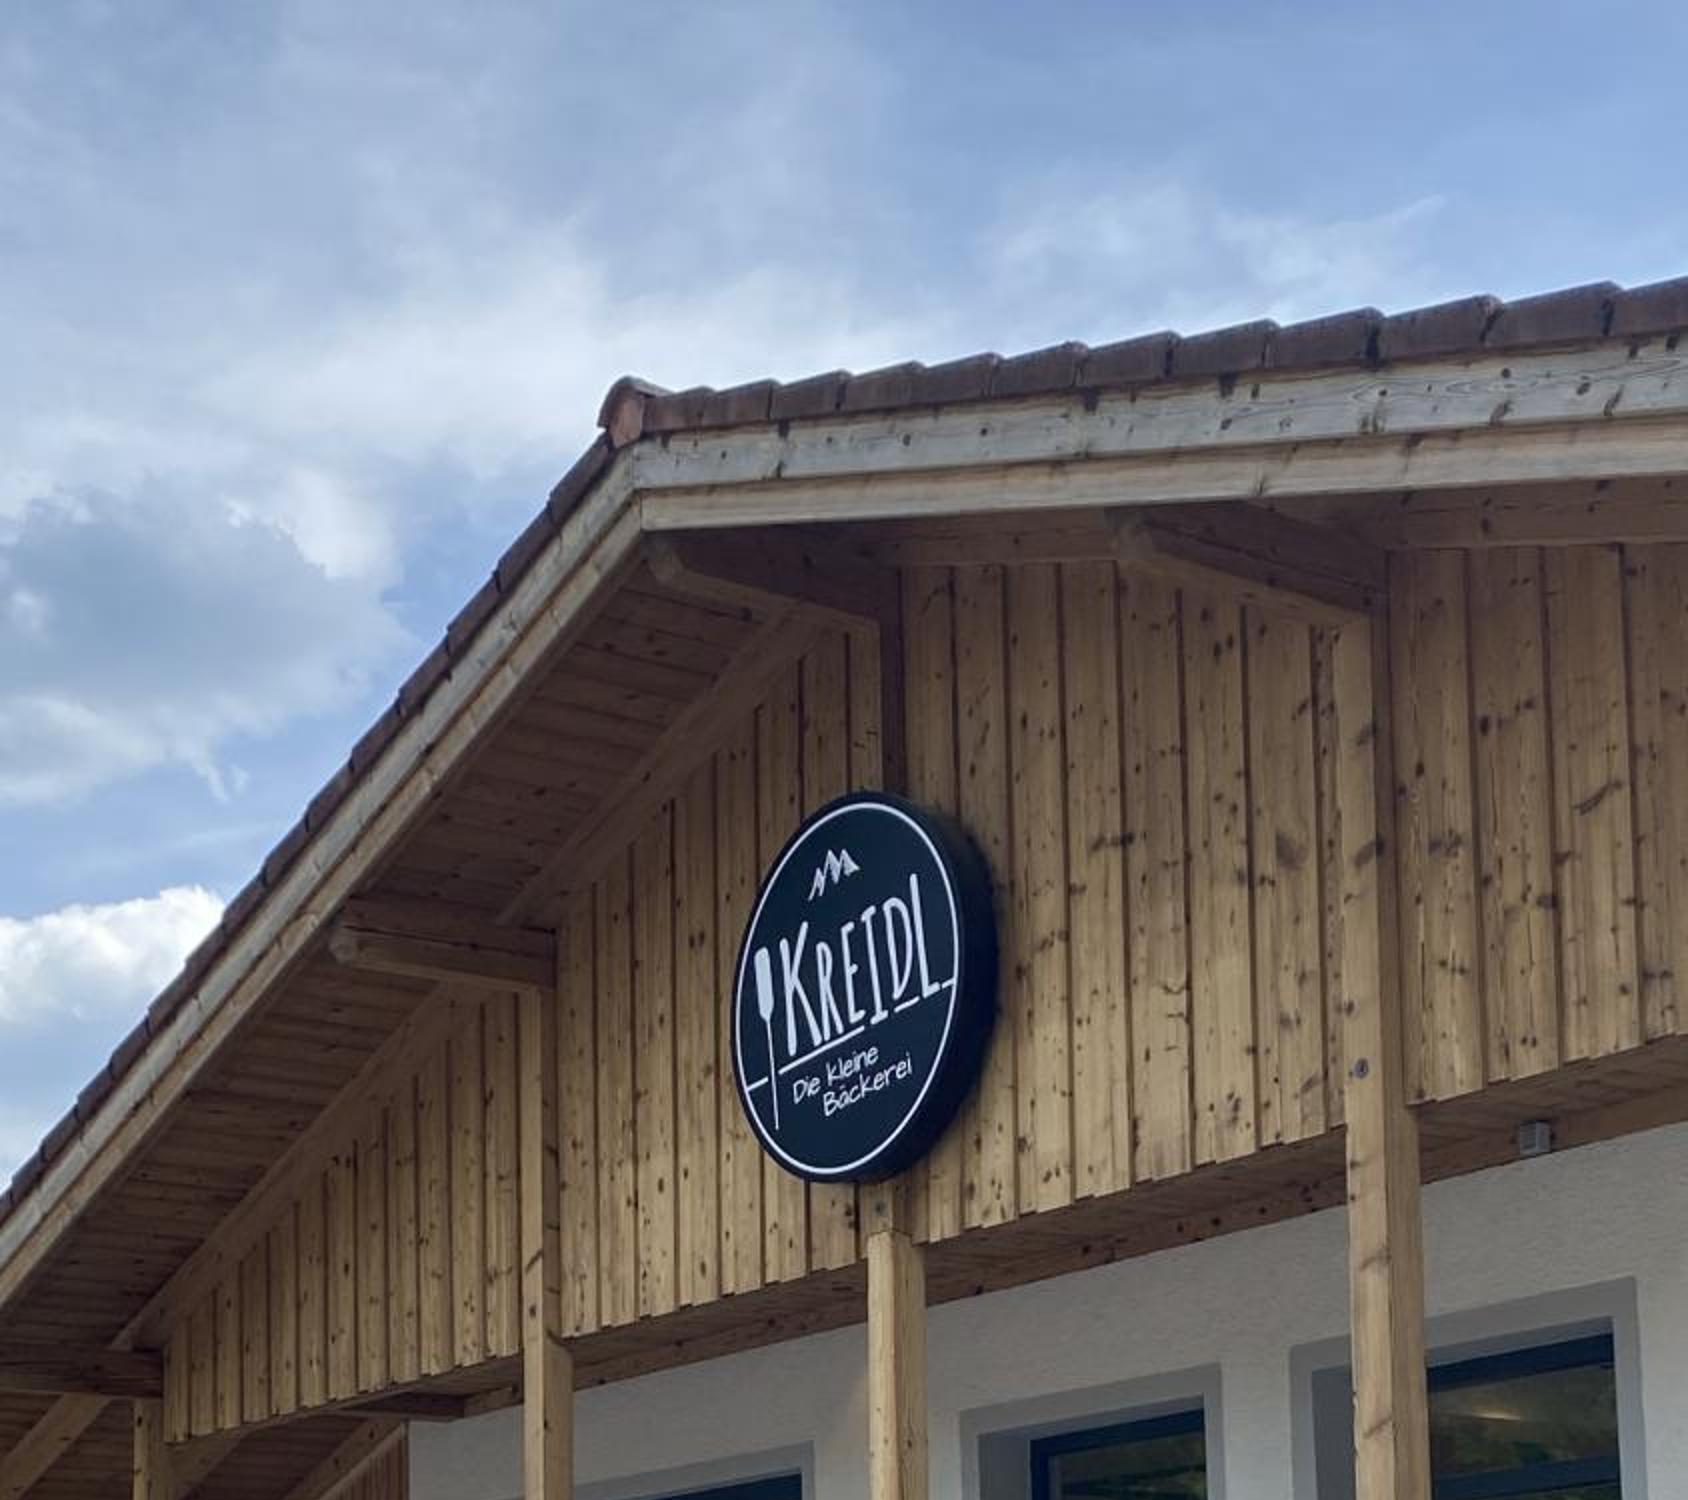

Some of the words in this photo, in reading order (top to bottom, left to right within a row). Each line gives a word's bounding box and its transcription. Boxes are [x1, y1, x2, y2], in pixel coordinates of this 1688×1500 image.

[780, 873, 940, 1056] KREIDL
[793, 1075, 820, 1104] Die
[826, 1046, 878, 1086] kleine
[823, 1051, 912, 1116] Bäckerei
